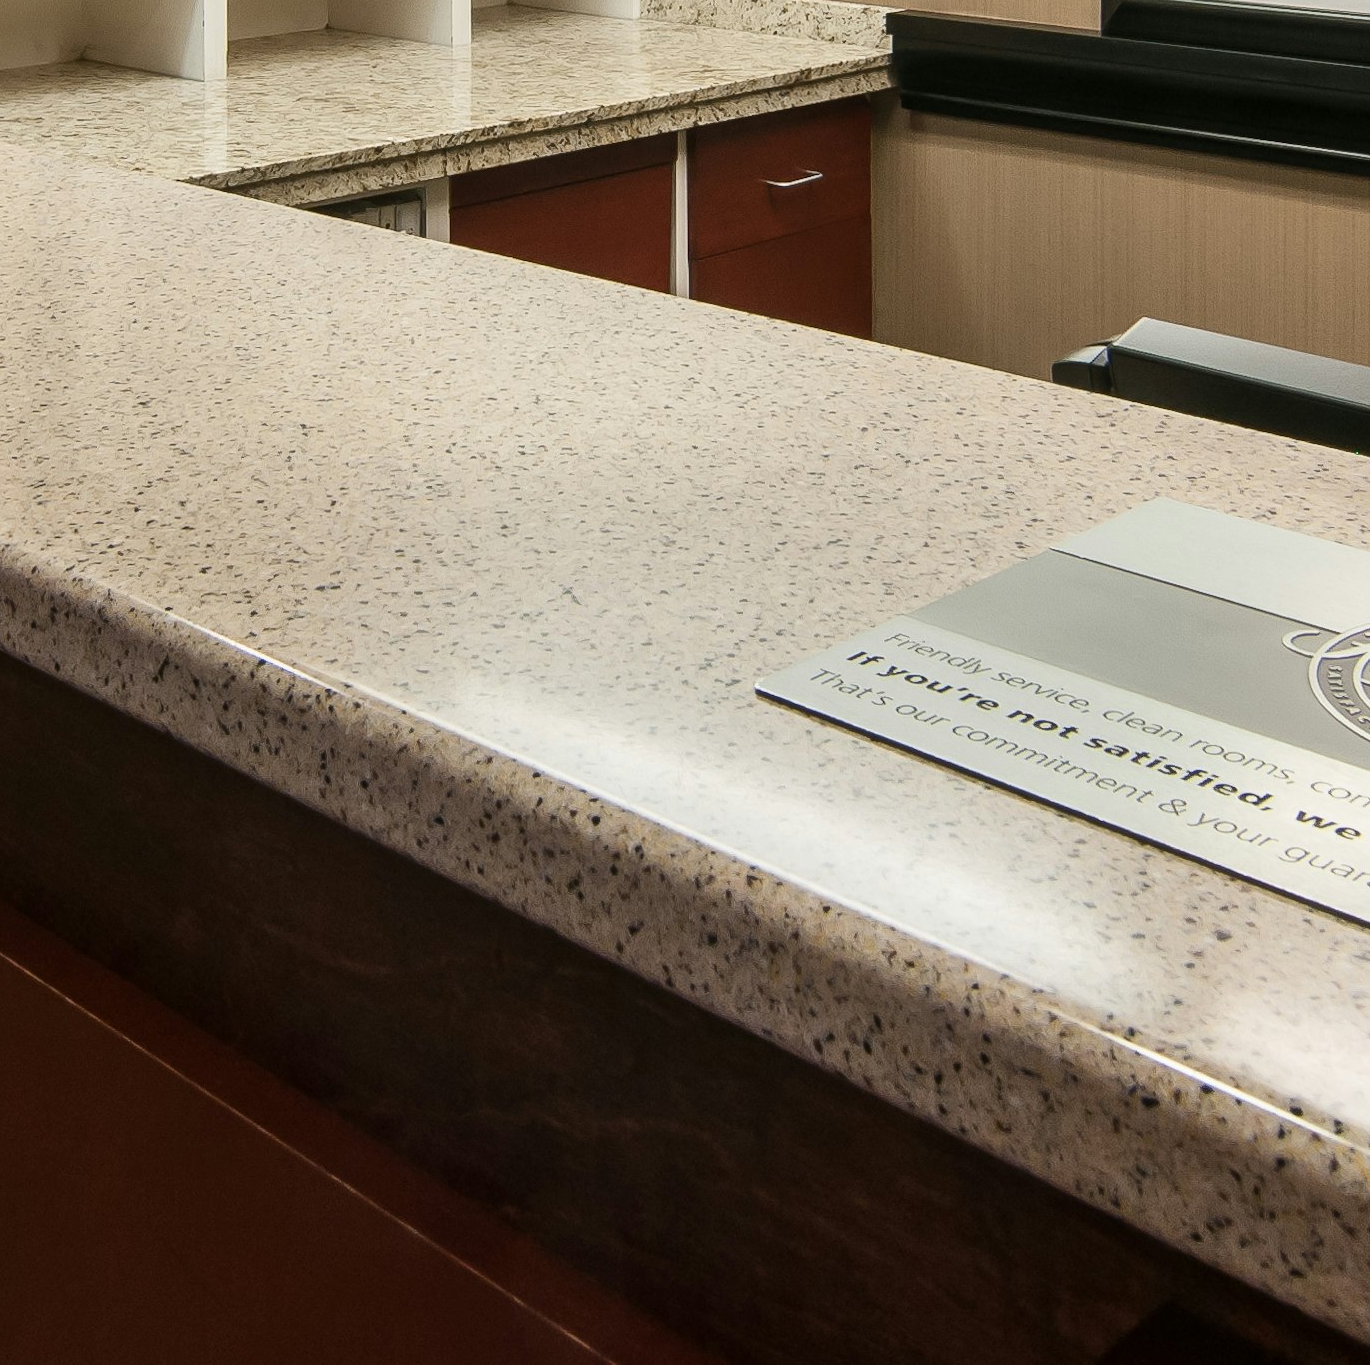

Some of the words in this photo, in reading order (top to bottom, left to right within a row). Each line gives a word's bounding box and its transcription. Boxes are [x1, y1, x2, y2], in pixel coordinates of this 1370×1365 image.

[810, 668, 894, 707] That's
[895, 703, 951, 726] our
[951, 724, 1154, 804] commitment
[1157, 797, 1188, 817] &
[1186, 811, 1279, 848] your
[846, 651, 885, 667] If
[876, 665, 1000, 711] you're
[1006, 709, 1080, 740] not
[1083, 736, 1274, 811] satisfied,
[1295, 810, 1362, 840] we
[884, 633, 992, 675] Friendly
[991, 670, 1091, 714] service,
[1102, 708, 1184, 743] clean
[1189, 739, 1296, 784] rooms,
